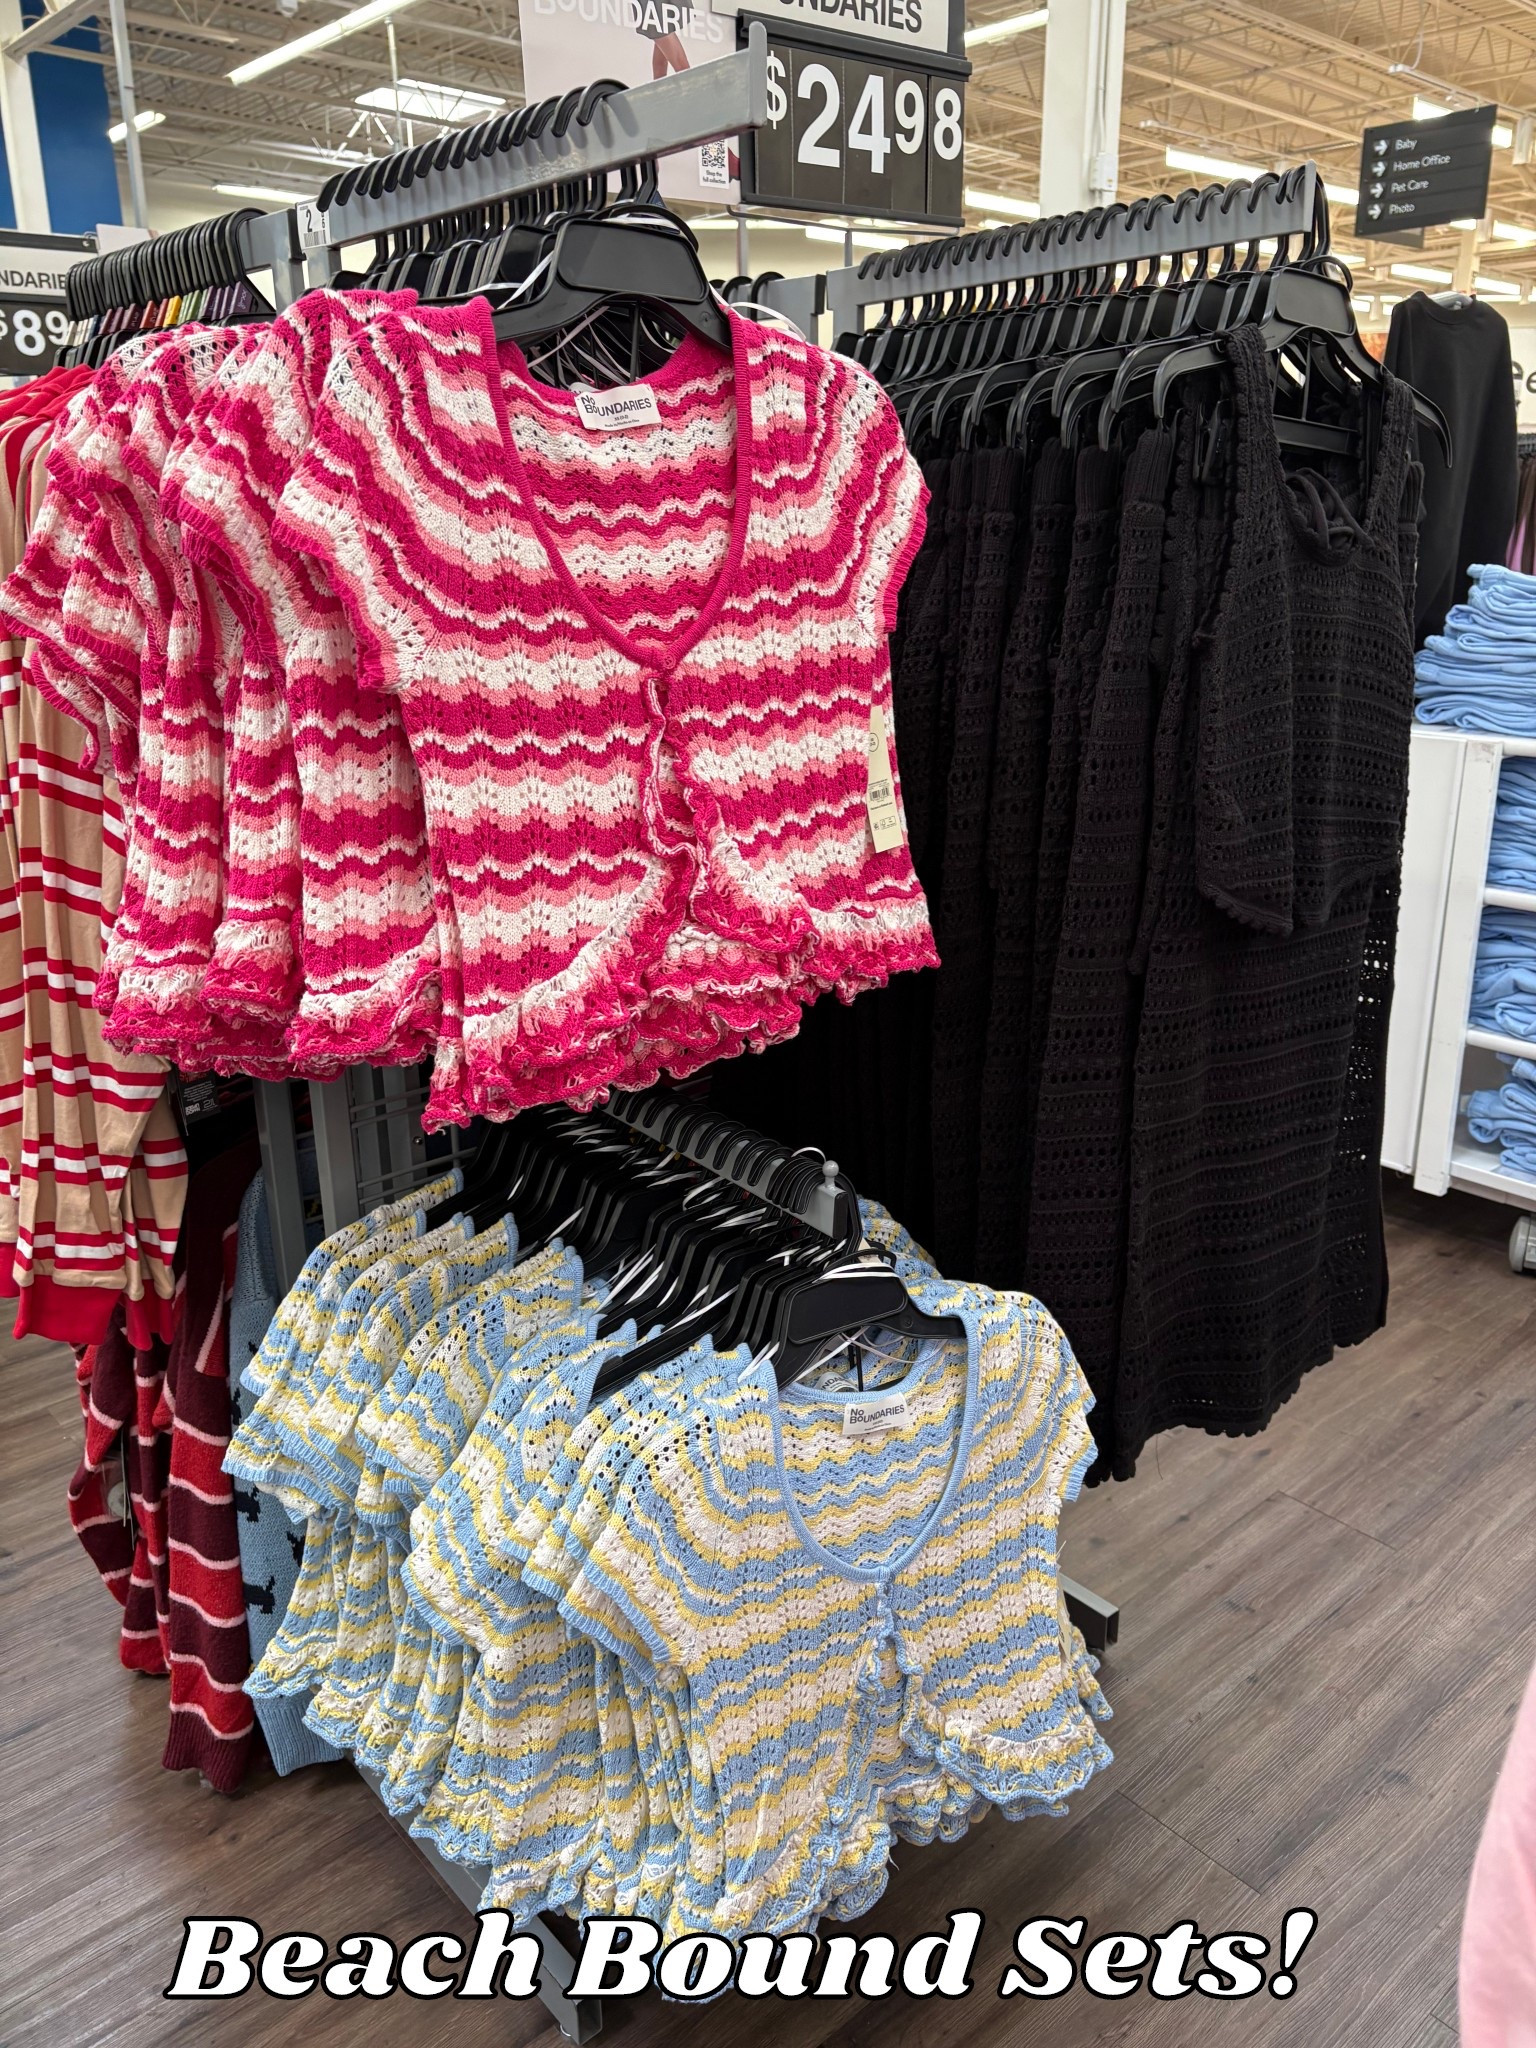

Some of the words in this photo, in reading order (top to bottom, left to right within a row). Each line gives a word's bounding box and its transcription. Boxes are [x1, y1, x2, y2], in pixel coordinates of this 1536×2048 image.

[779, 0, 922, 33] ARIES
[1395, 139, 1418, 150] Baby
[1393, 161, 1420, 171] Home
[1421, 154, 1451, 166] Office
[1391, 182, 1406, 193] Pet
[1408, 180, 1430, 191] Care
[1389, 203, 1415, 215] Photo
